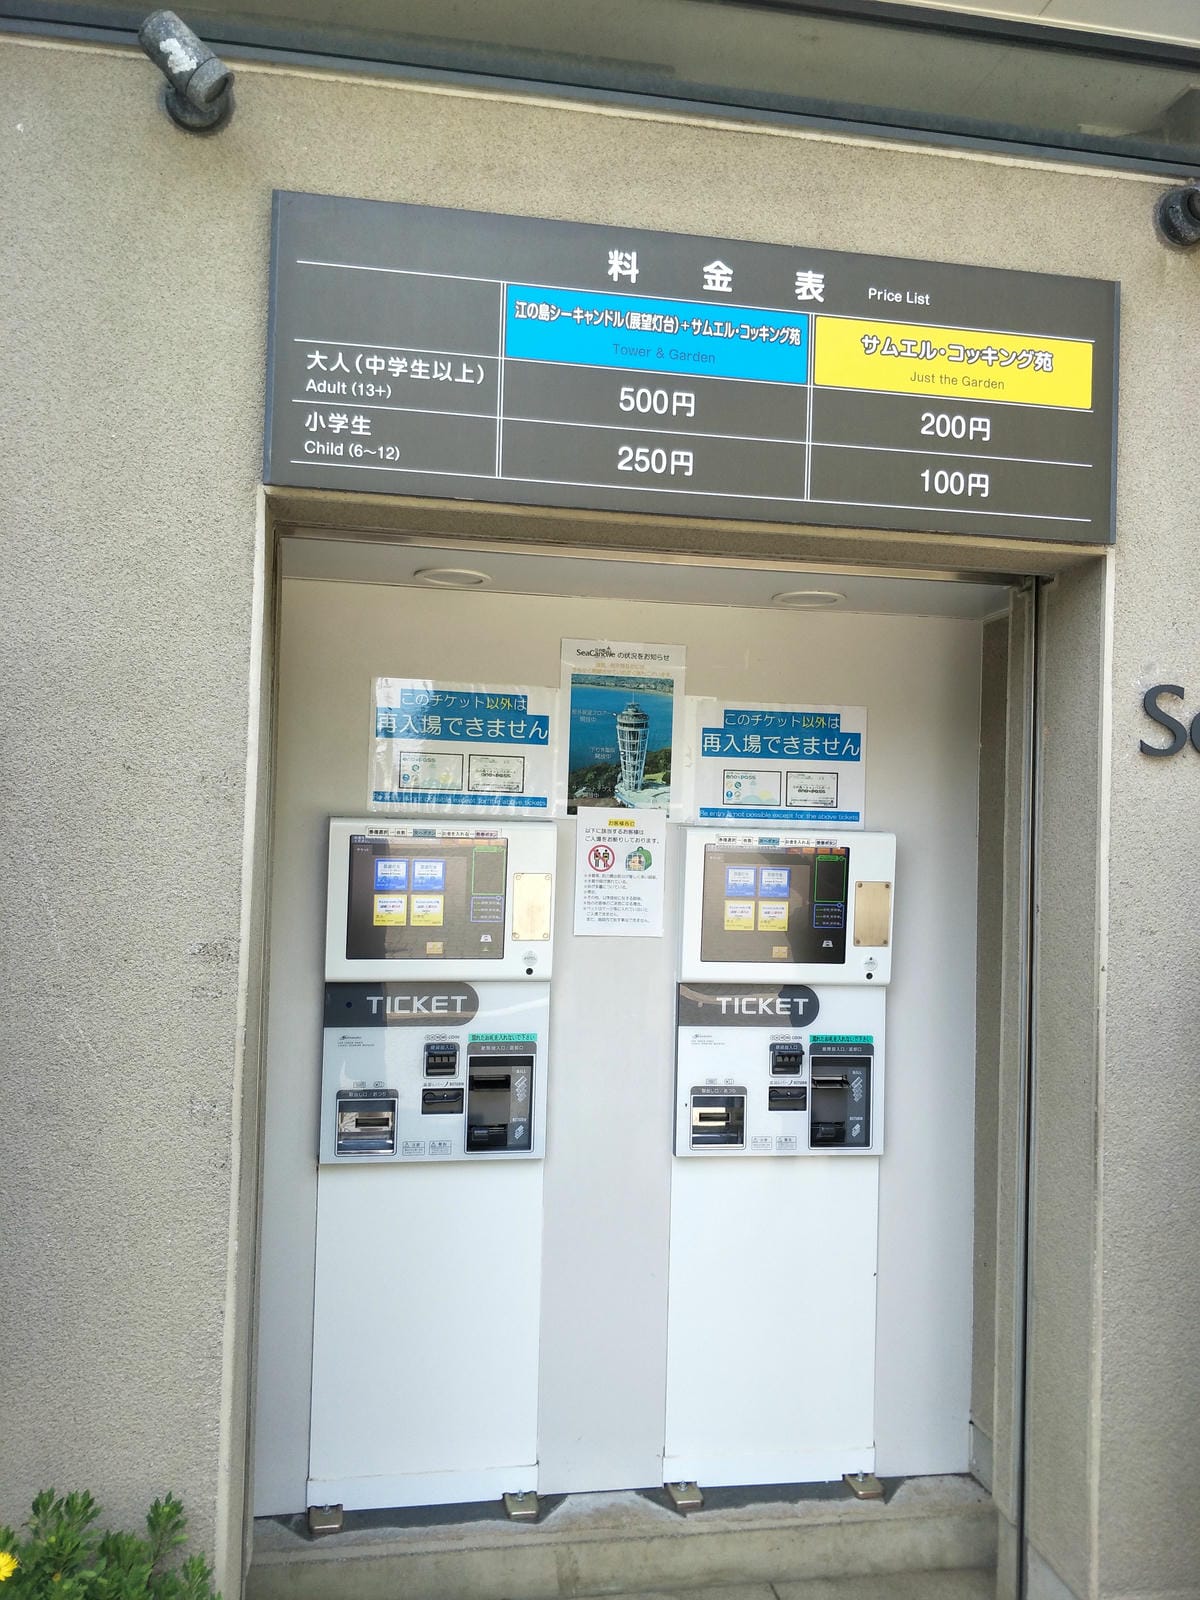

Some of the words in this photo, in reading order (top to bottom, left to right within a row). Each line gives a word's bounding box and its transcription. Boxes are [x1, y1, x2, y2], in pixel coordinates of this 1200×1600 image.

[608, 249, 639, 284] 料
[702, 260, 734, 293] 金
[794, 270, 825, 303] 表
[867, 287, 903, 303] Price
[906, 290, 930, 306] List
[612, 343, 652, 358] Tower
[656, 347, 665, 358] &
[669, 348, 716, 364] Garden
[860, 334, 1054, 374] サムエル・コッキング苑
[305, 349, 486, 386] 大人(中学生以上)
[305, 379, 347, 396] Adult
[351, 382, 392, 400] (13+)
[910, 371, 936, 385] Just
[939, 373, 959, 386] the
[961, 376, 1005, 391] Garden
[618, 386, 697, 418] 500円
[304, 411, 372, 437] 小学生
[919, 411, 992, 443] 200円
[304, 440, 344, 457] Child
[616, 446, 694, 478] 250円
[919, 469, 990, 498] 100円
[400, 692, 528, 711] このチケット以外は
[376, 712, 549, 740] 再入場できません
[724, 713, 841, 729] このチケット以外は
[703, 733, 861, 757] 再入場できません
[366, 995, 468, 1015] TICKET
[716, 997, 809, 1016] TICKET
